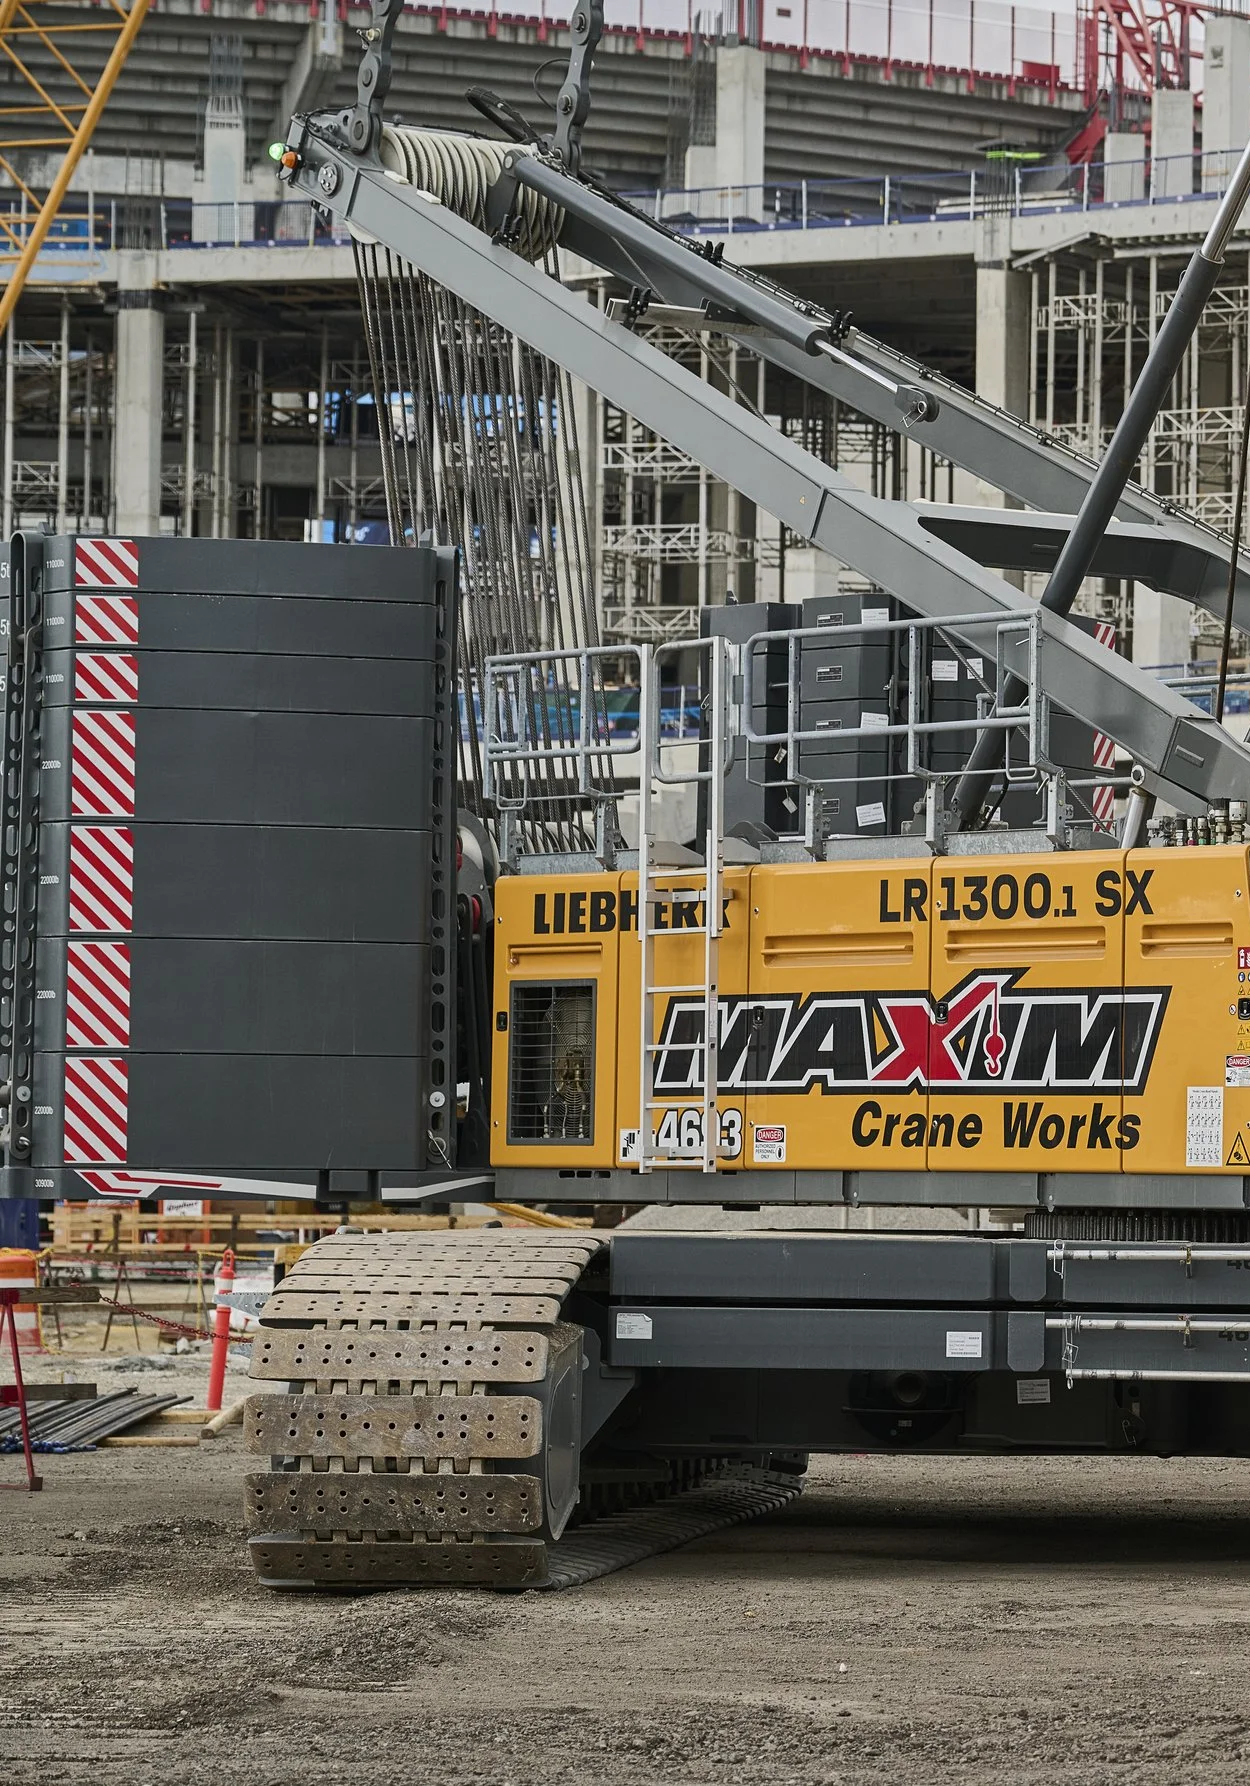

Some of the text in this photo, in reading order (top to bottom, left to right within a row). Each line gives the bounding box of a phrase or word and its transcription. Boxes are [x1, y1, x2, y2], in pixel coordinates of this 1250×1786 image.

[879, 869, 1155, 923] LR 1300.1 SX
[653, 967, 1172, 1097] MAXIM
[759, 1130, 782, 1139] DANGER
[851, 1100, 983, 1149] Crane
[1002, 1102, 1142, 1150] Works
